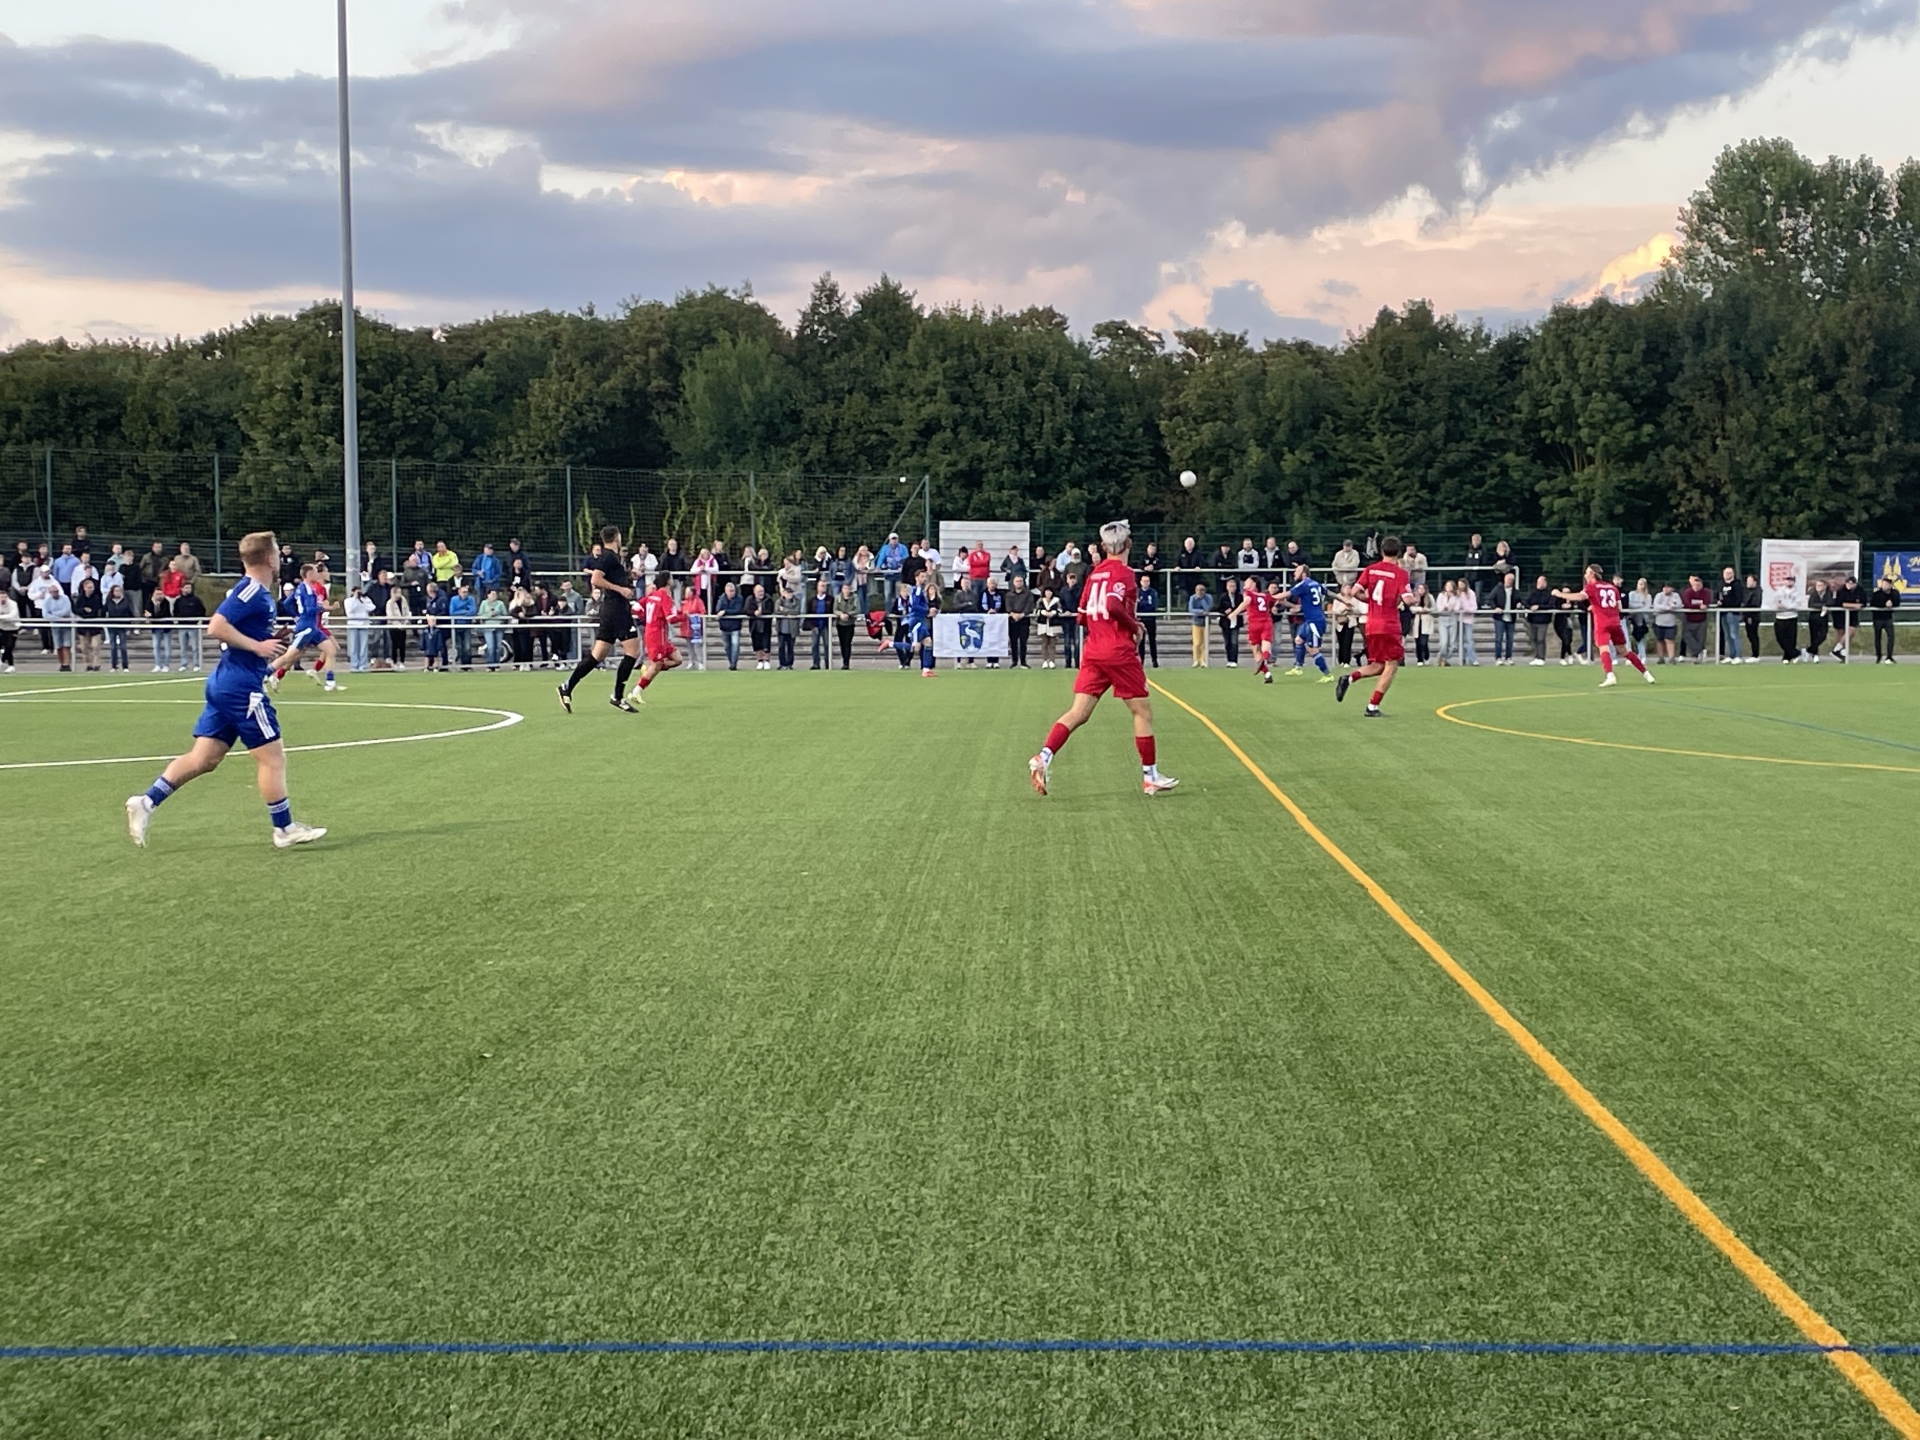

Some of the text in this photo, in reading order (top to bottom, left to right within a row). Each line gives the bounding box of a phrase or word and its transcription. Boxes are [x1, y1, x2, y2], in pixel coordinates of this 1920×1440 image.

[1086, 581, 1109, 621] 44
[1257, 596, 1267, 611] 2
[1372, 580, 1384, 606] 4
[1599, 589, 1617, 608] 23
